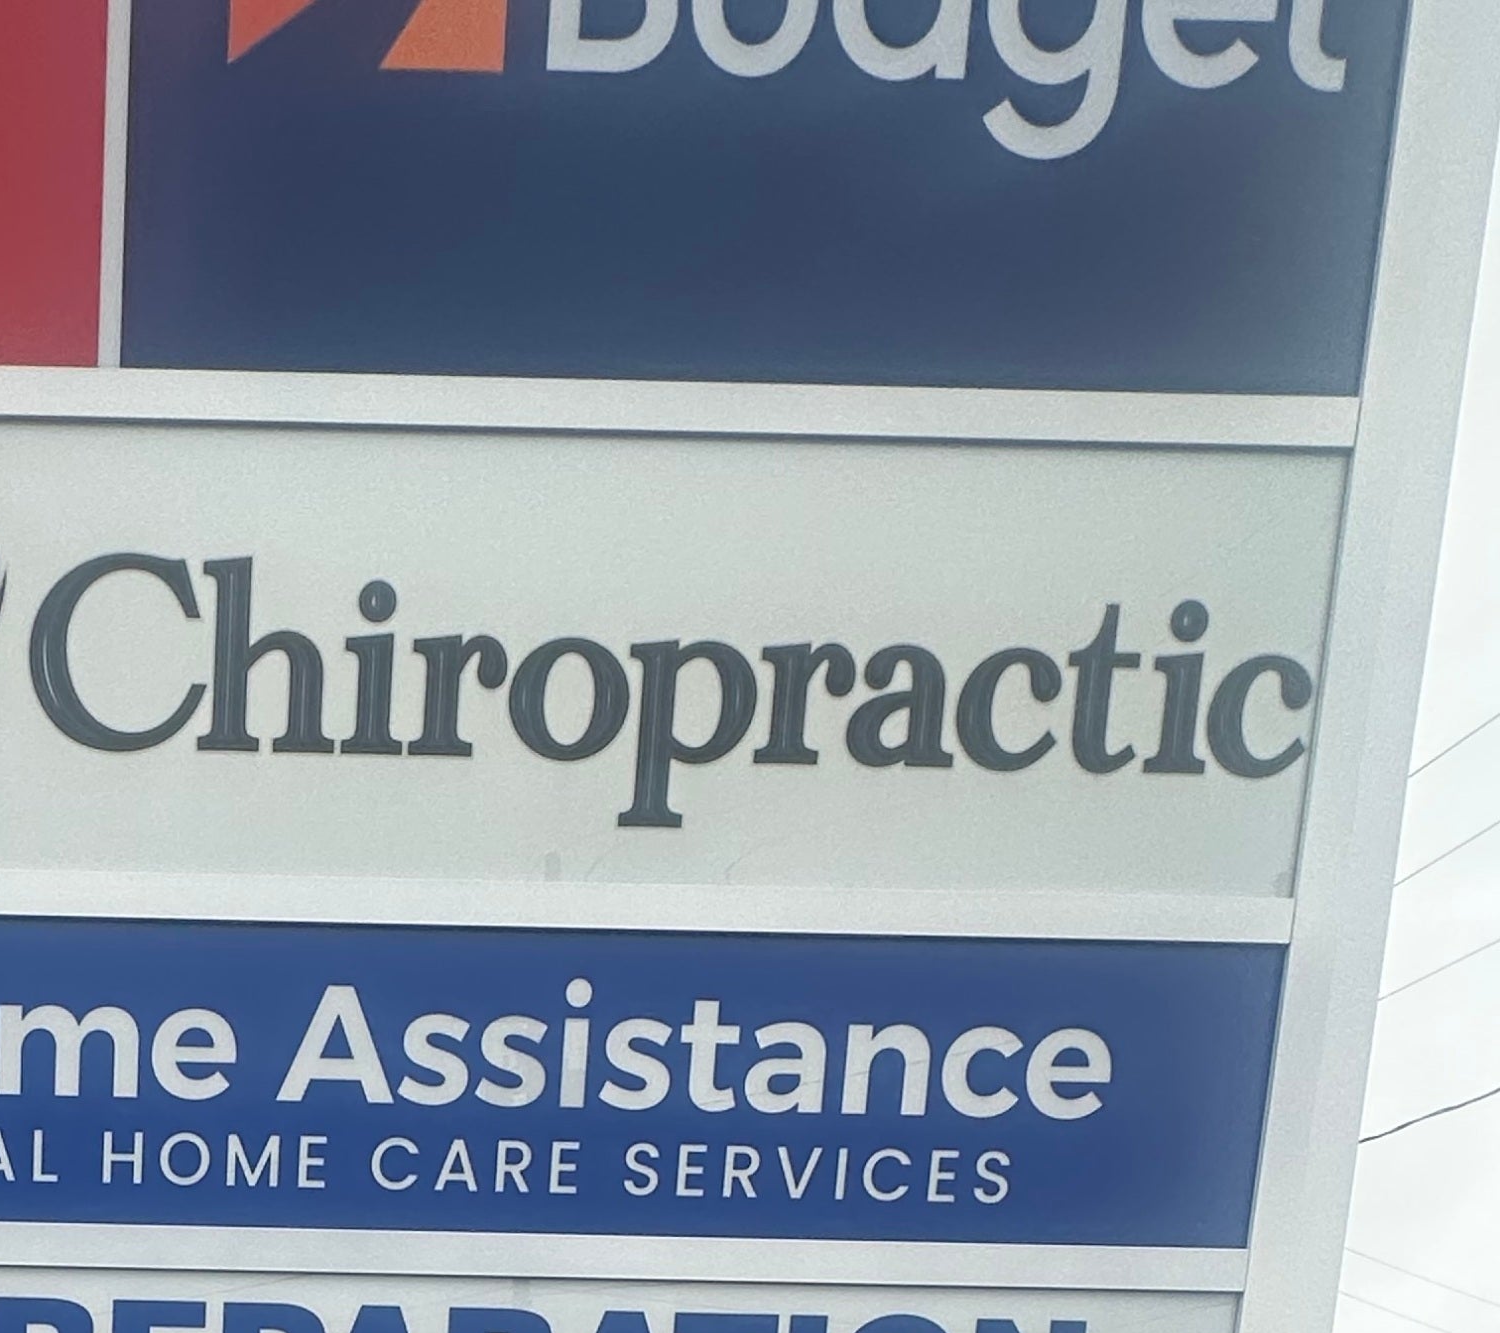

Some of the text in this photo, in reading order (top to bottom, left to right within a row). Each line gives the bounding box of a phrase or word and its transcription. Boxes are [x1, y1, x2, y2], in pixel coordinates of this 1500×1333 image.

[29, 553, 1314, 828] Chiropractic
[276, 979, 1111, 1119] Assistance
[103, 1132, 327, 1188] HOME
[372, 1138, 579, 1193] CARE
[624, 1143, 1009, 1203] SERVICES
